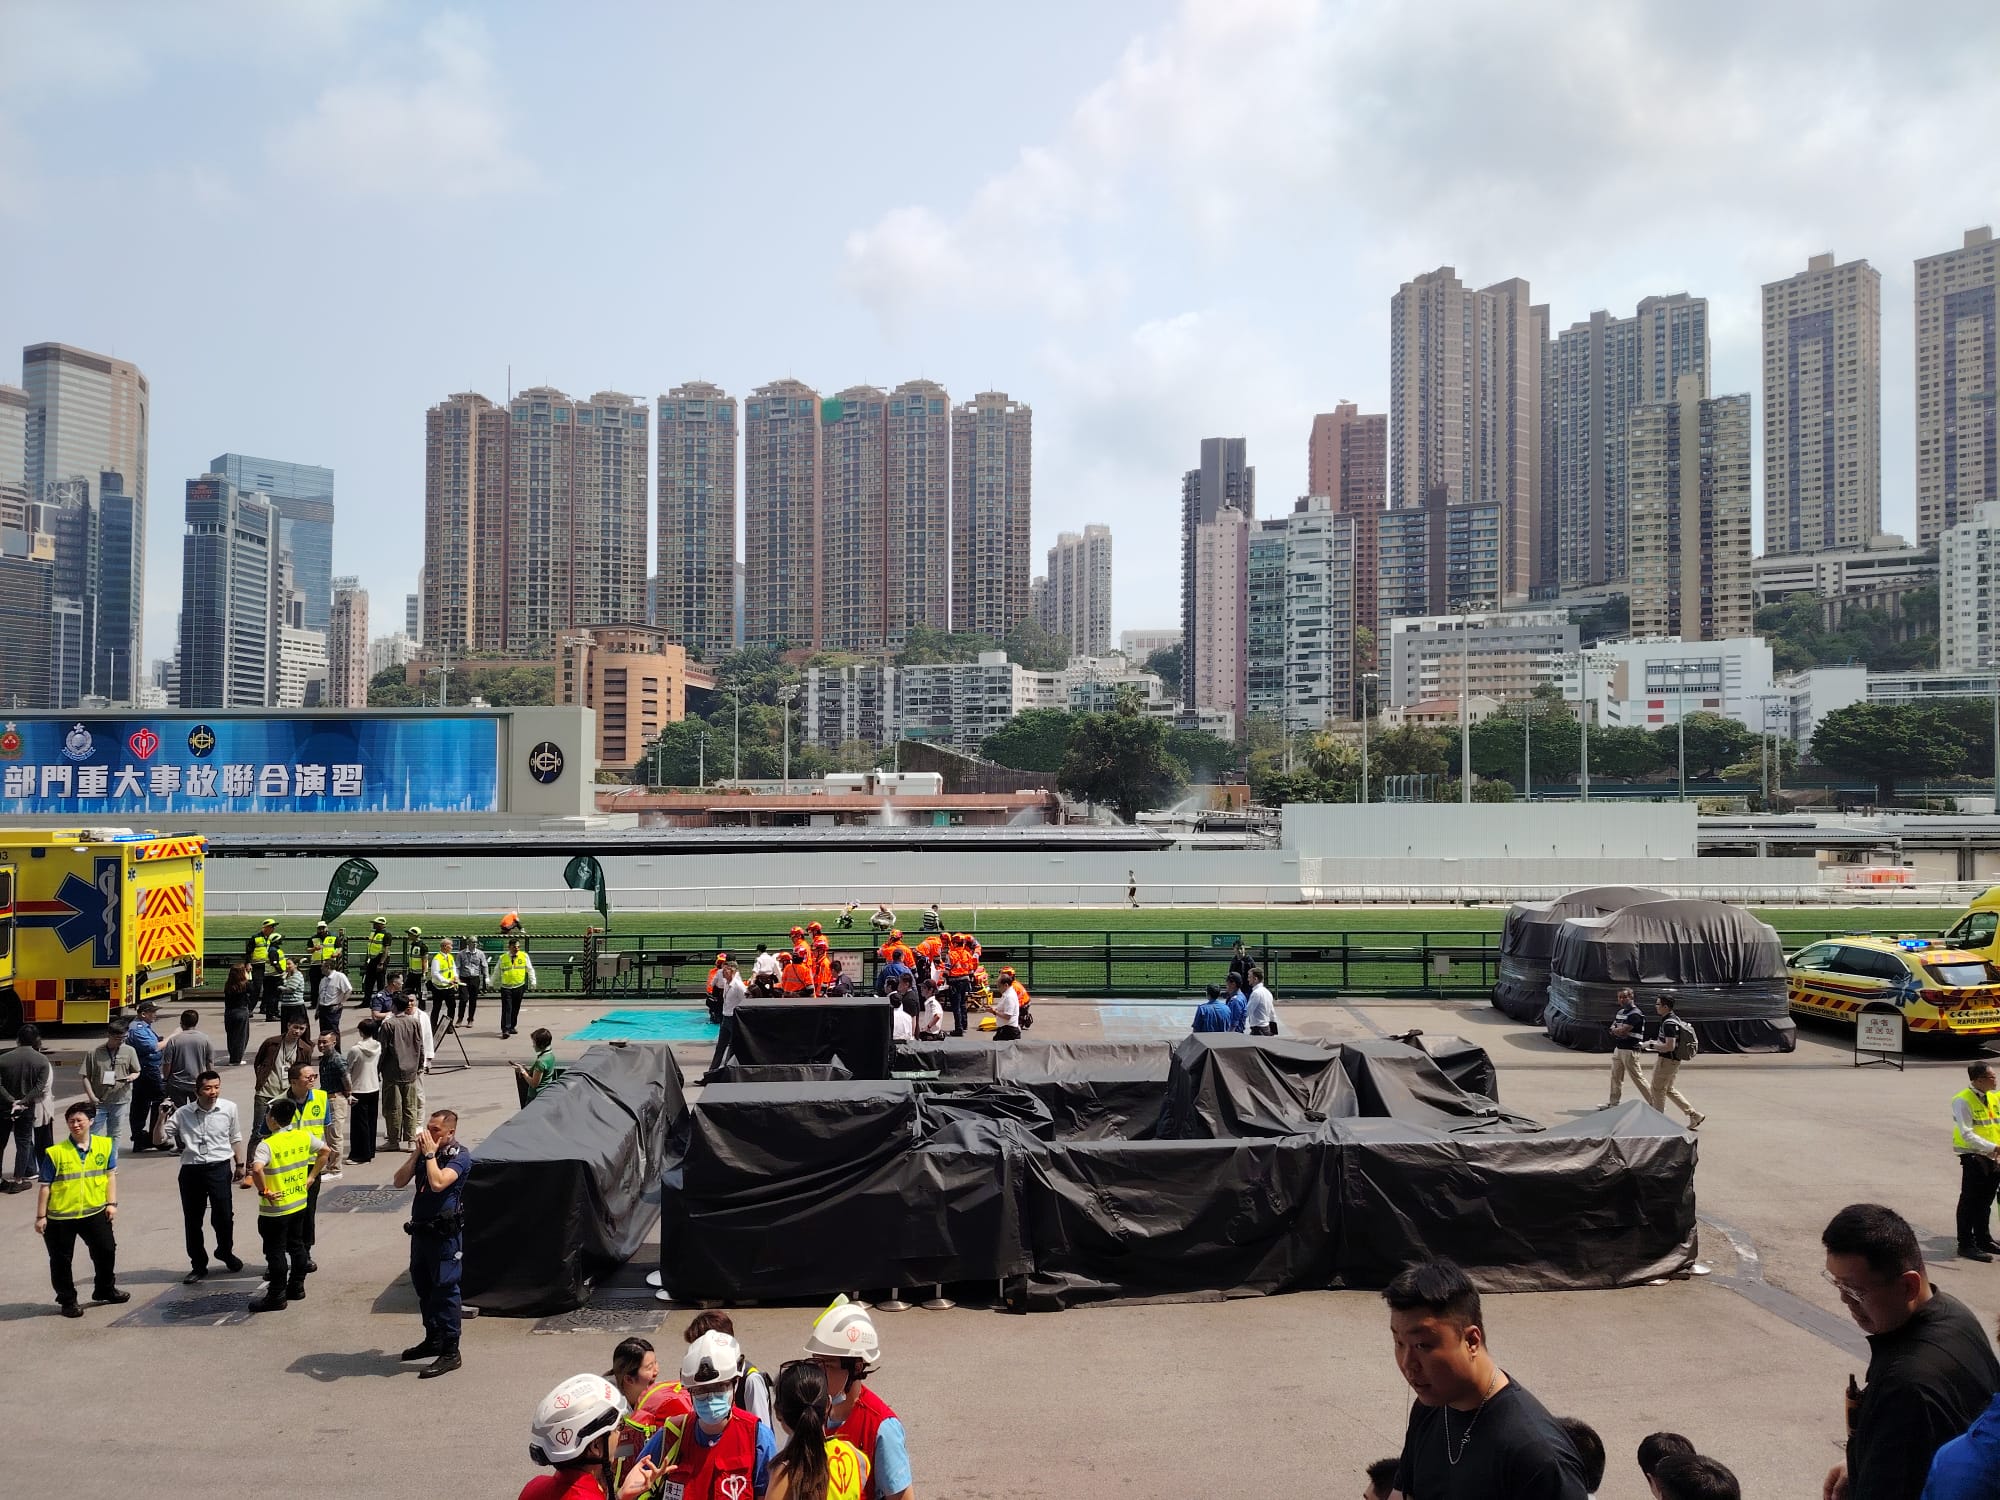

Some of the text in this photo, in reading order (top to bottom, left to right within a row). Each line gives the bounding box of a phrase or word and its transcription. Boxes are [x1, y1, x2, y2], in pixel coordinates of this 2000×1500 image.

[4, 764, 364, 798] 部門重大事故聯合演習
[336, 886, 355, 898] EXIT
[331, 898, 347, 907] 出口
[284, 1172, 304, 1185] HKJC
[281, 1183, 307, 1198] ECURIT
